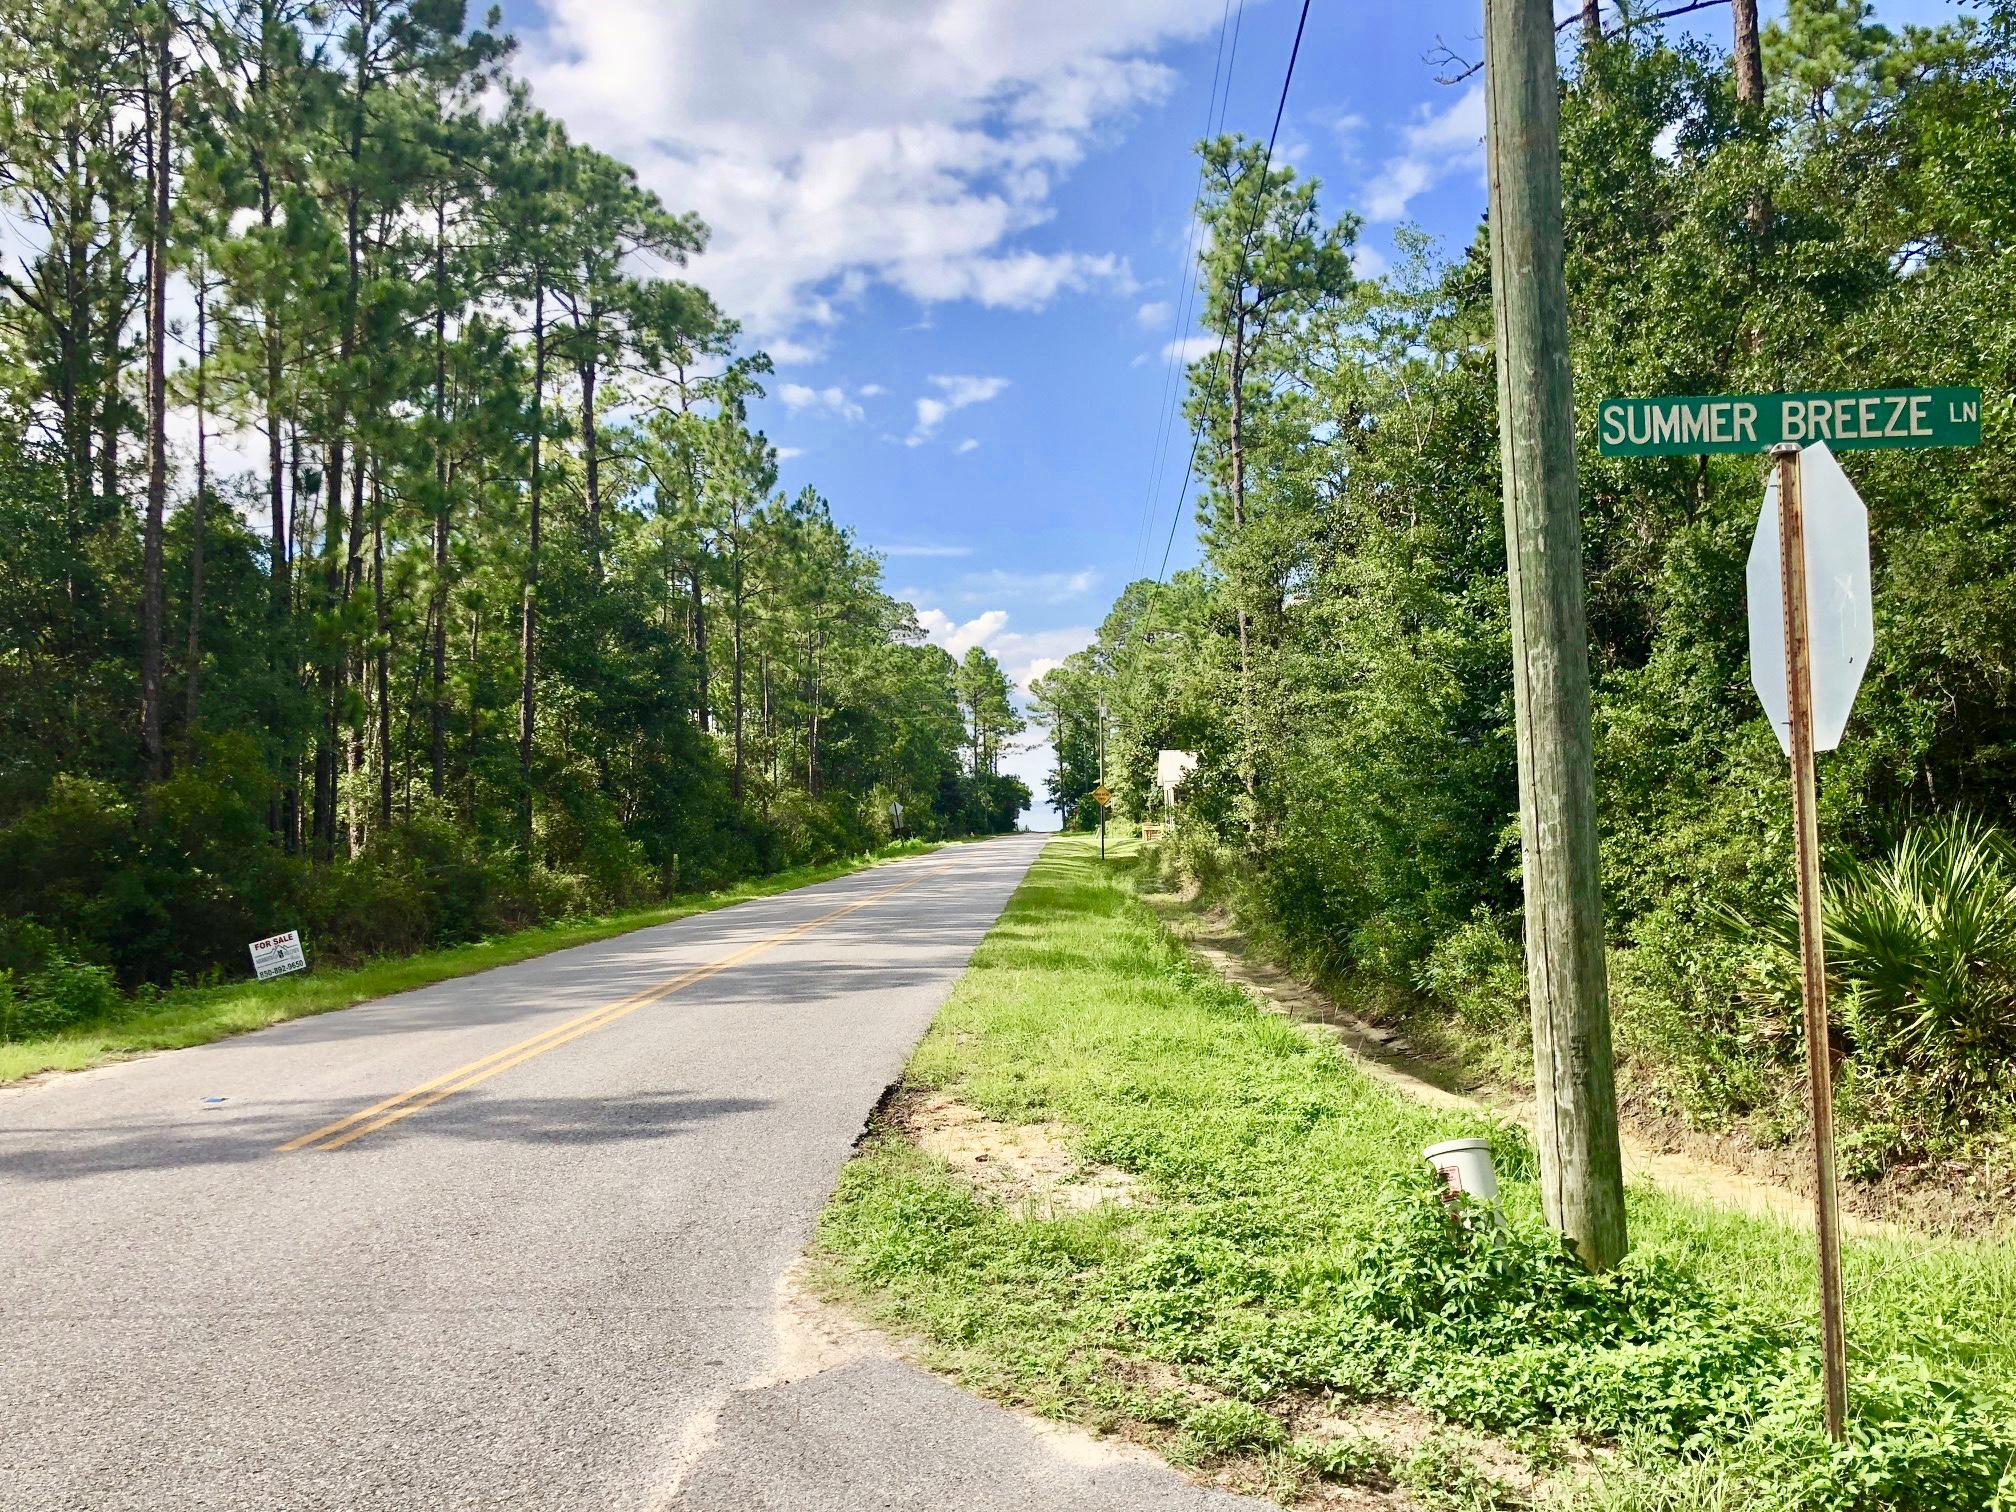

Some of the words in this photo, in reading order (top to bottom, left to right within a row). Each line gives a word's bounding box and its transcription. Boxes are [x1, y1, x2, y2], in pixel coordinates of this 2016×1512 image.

[1603, 402, 1758, 445] SUMMER
[1782, 395, 1933, 440] BREEZE
[1950, 401, 1977, 423] LN
[255, 941, 271, 950] FOR
[273, 934, 293, 945] SALE
